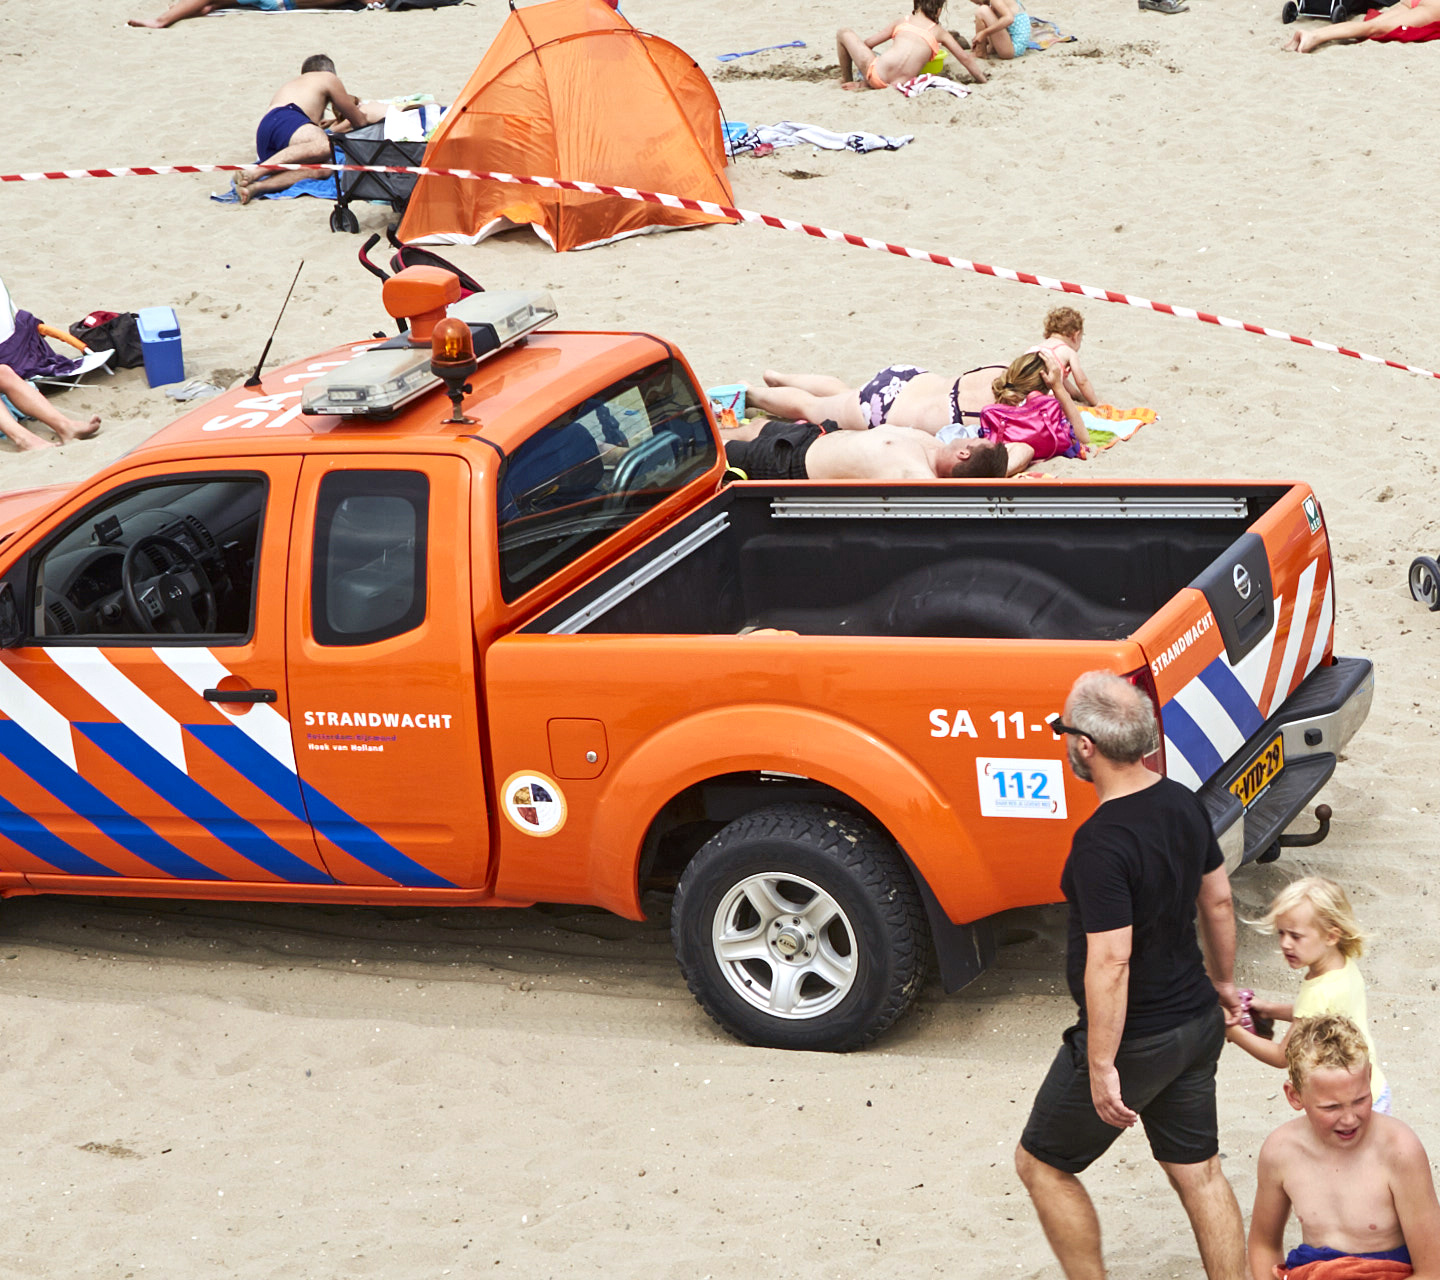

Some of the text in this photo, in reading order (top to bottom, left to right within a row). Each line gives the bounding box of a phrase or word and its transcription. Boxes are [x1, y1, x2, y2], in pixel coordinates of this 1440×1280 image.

[1151, 611, 1214, 677] STRANDWACHT
[304, 711, 452, 728] STRANDWACHT
[929, 709, 978, 738] SA
